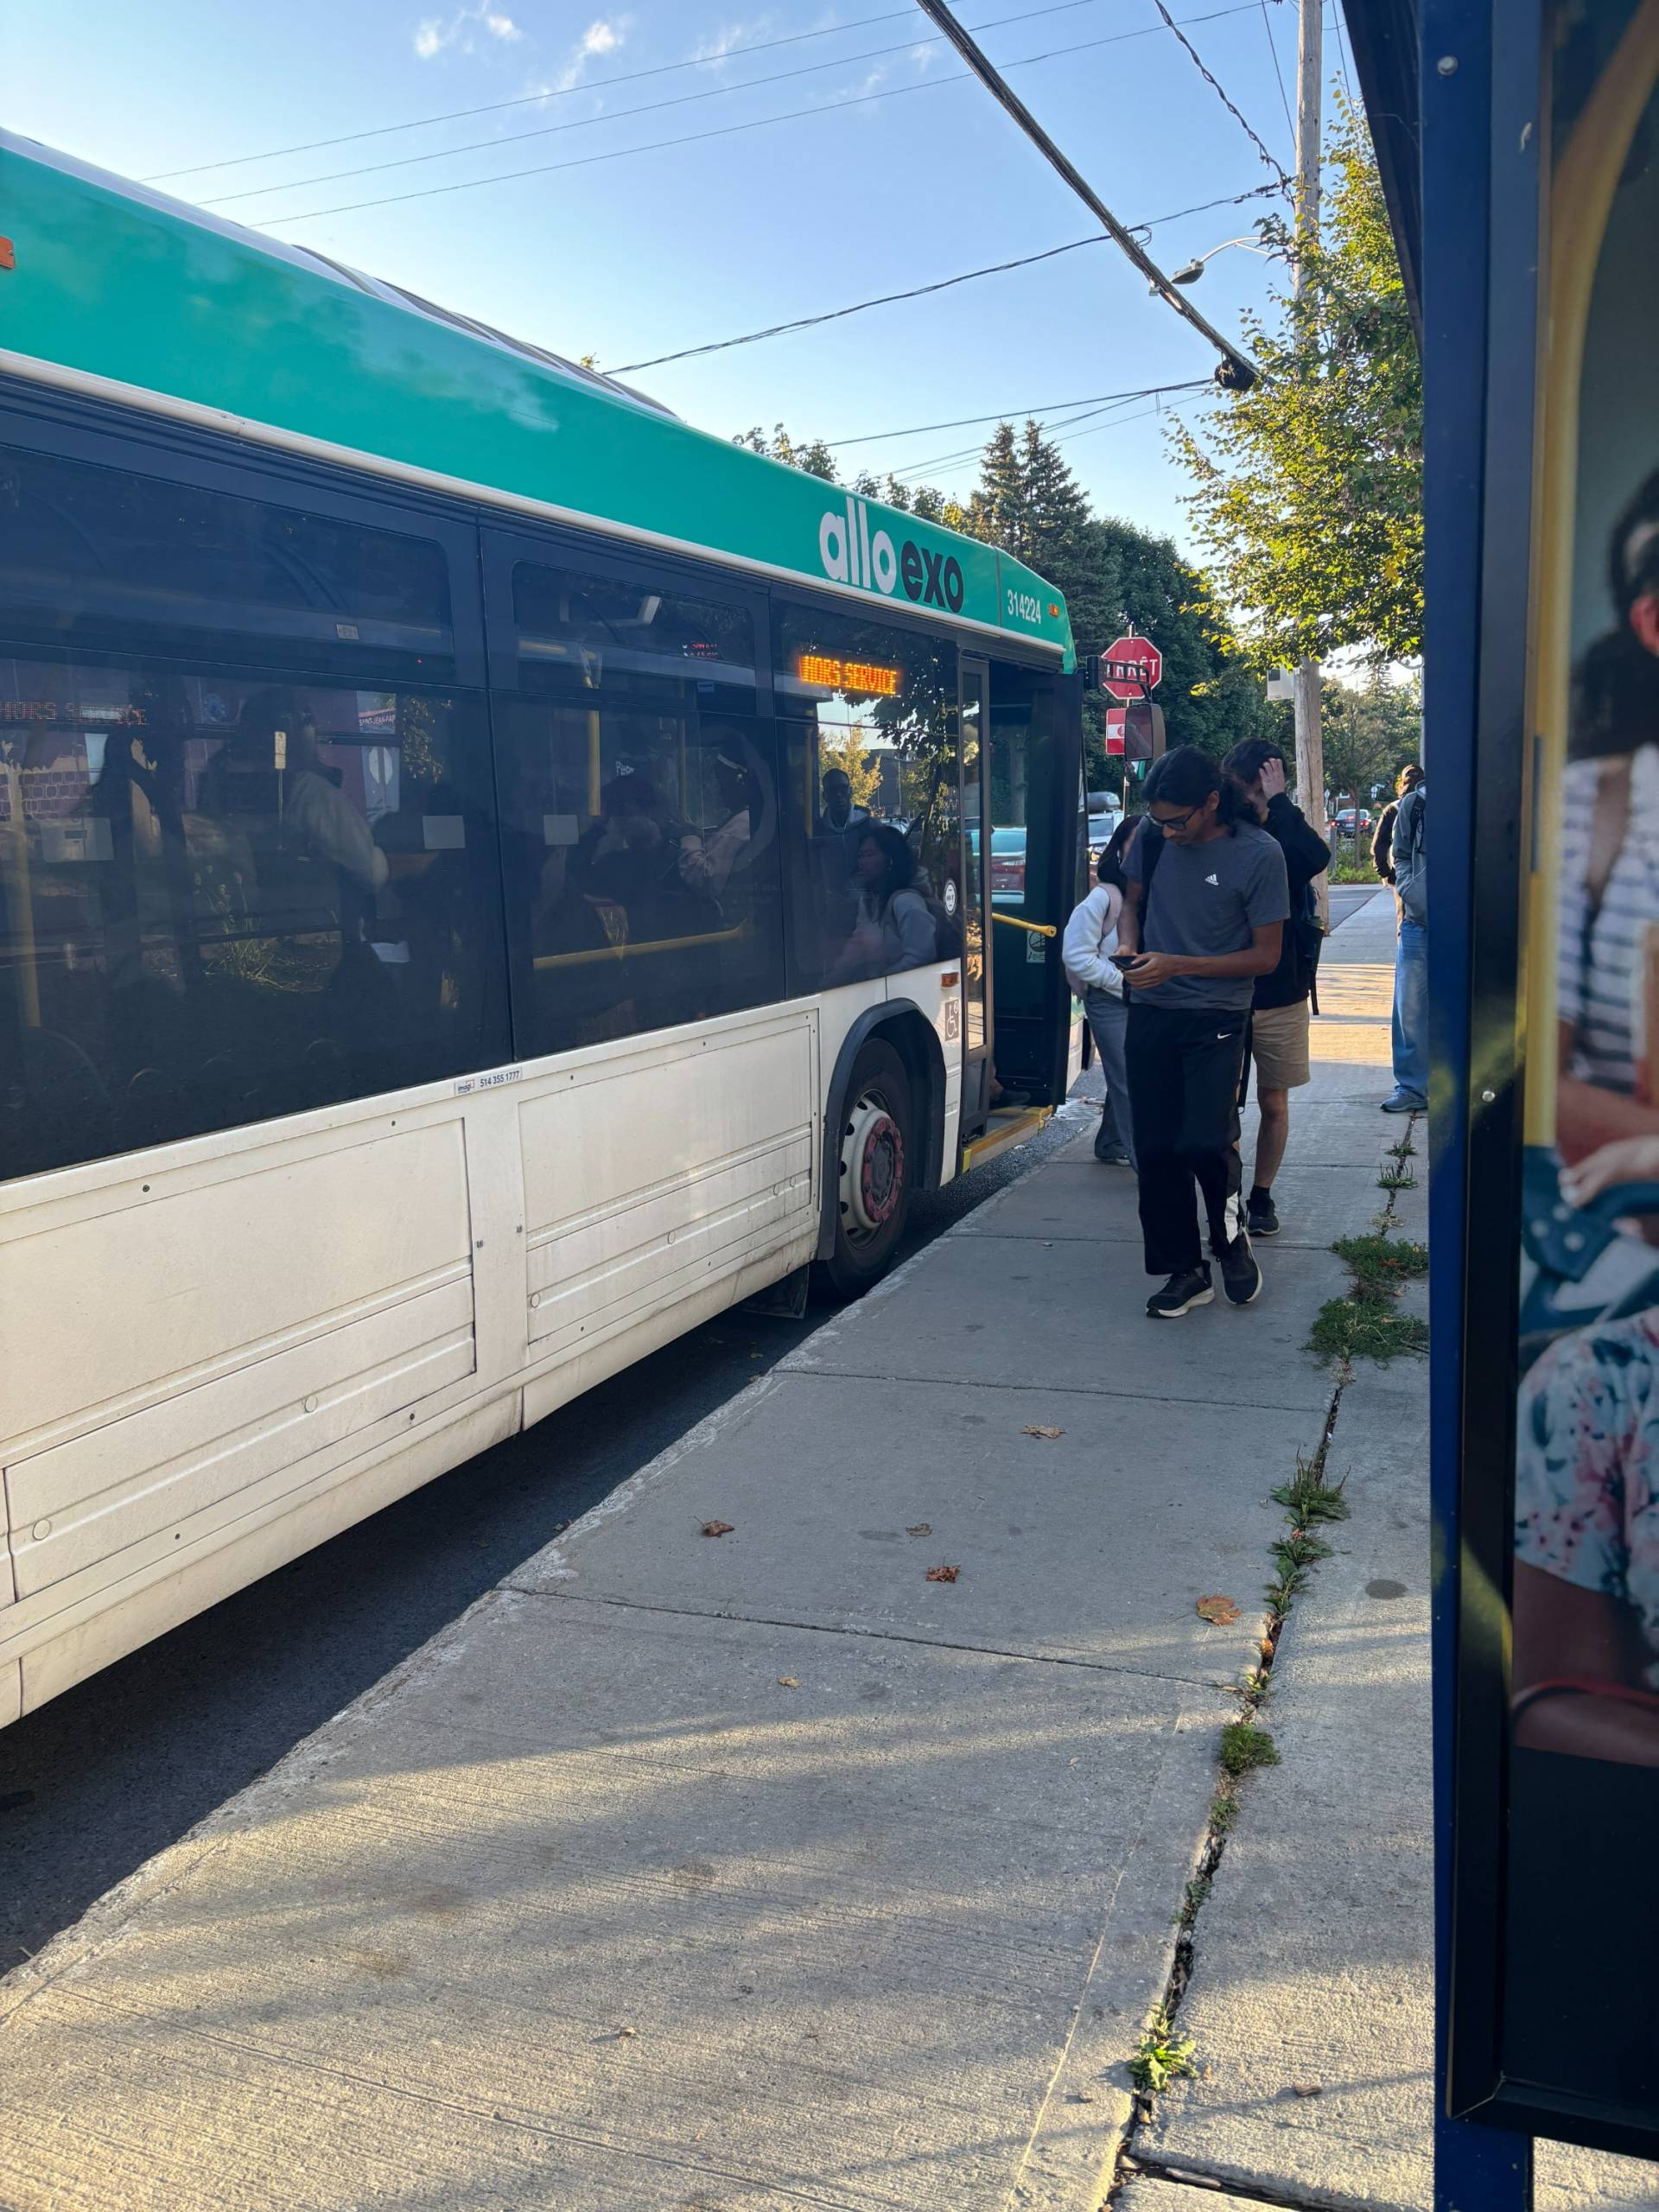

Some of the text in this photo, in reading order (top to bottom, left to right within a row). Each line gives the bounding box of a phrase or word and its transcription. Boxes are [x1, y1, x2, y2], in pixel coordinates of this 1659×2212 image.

[819, 497, 964, 613] allo exo
[1007, 589, 1041, 625] 314224
[480, 1077, 492, 1087] 514
[493, 1074, 504, 1084] 355
[505, 1071, 519, 1081] 1777
